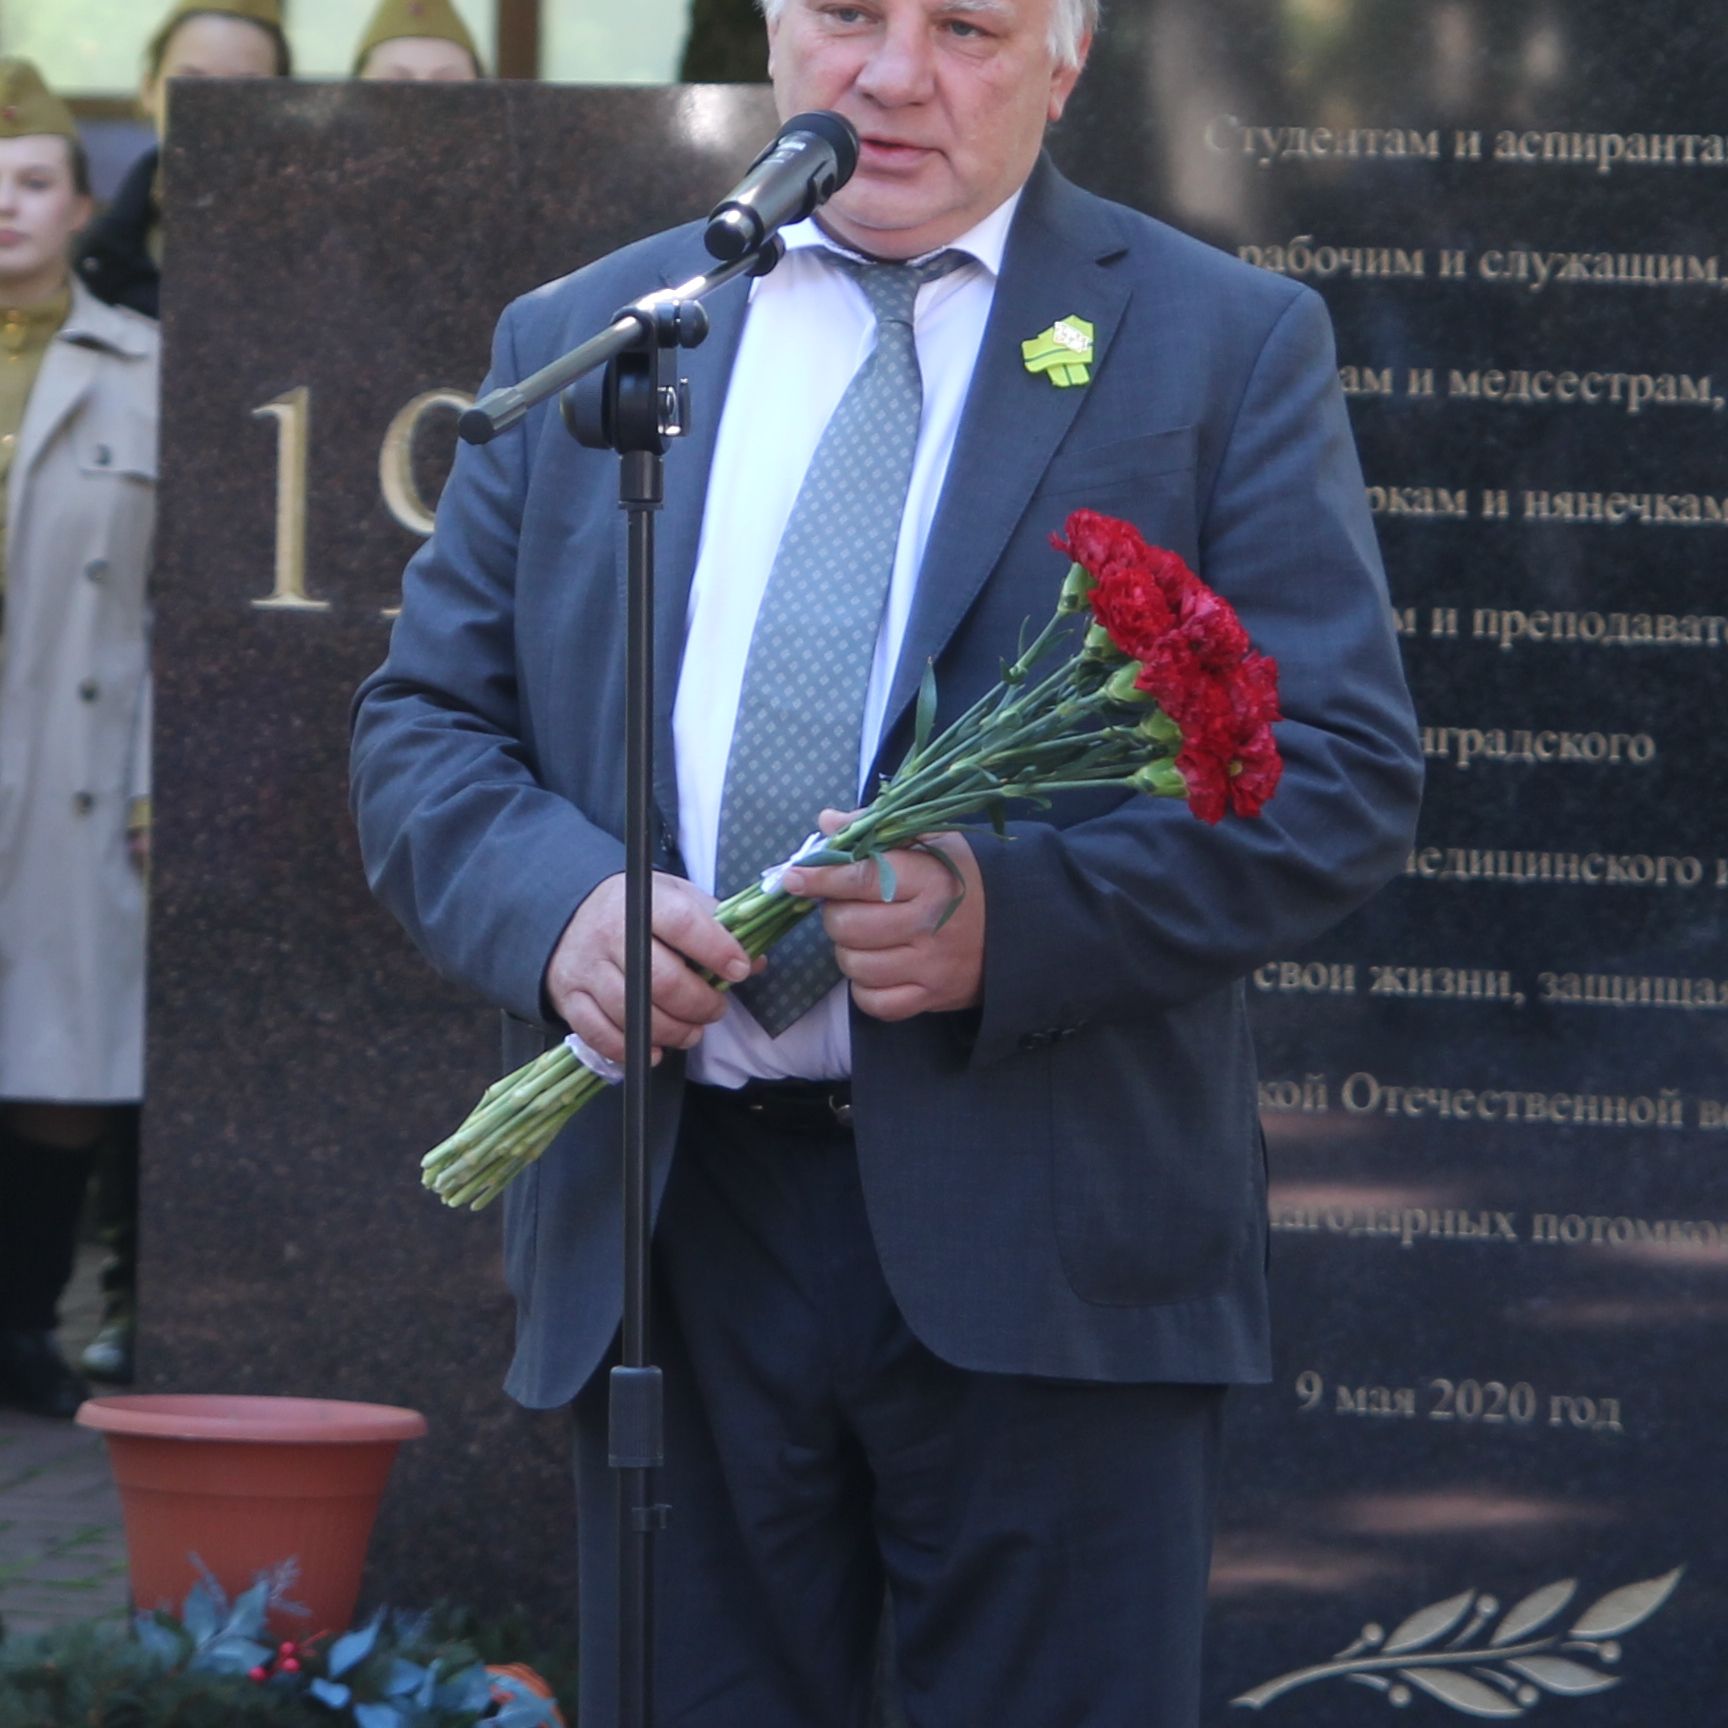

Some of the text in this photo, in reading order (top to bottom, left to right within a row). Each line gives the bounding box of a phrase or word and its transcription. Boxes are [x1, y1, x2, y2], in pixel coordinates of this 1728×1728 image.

[1203, 114, 1440, 167] Студентам
[1453, 129, 1482, 158] и
[1237, 234, 1424, 277] рабочим
[1438, 248, 1467, 277] и
[1339, 365, 1726, 412] ам и медсестрам,
[250, 385, 477, 619] 19
[1364, 485, 1468, 517] ркам
[1481, 489, 1510, 519] и
[1430, 607, 1459, 637] и
[1253, 961, 1357, 994] свои
[1368, 965, 1528, 1010] жизни,
[1257, 1072, 1330, 1112] кой
[1341, 1072, 1684, 1131] Отечественной
[1269, 1204, 1518, 1250] агодарных
[1294, 1370, 1623, 1434] 9 мая 2020 год
